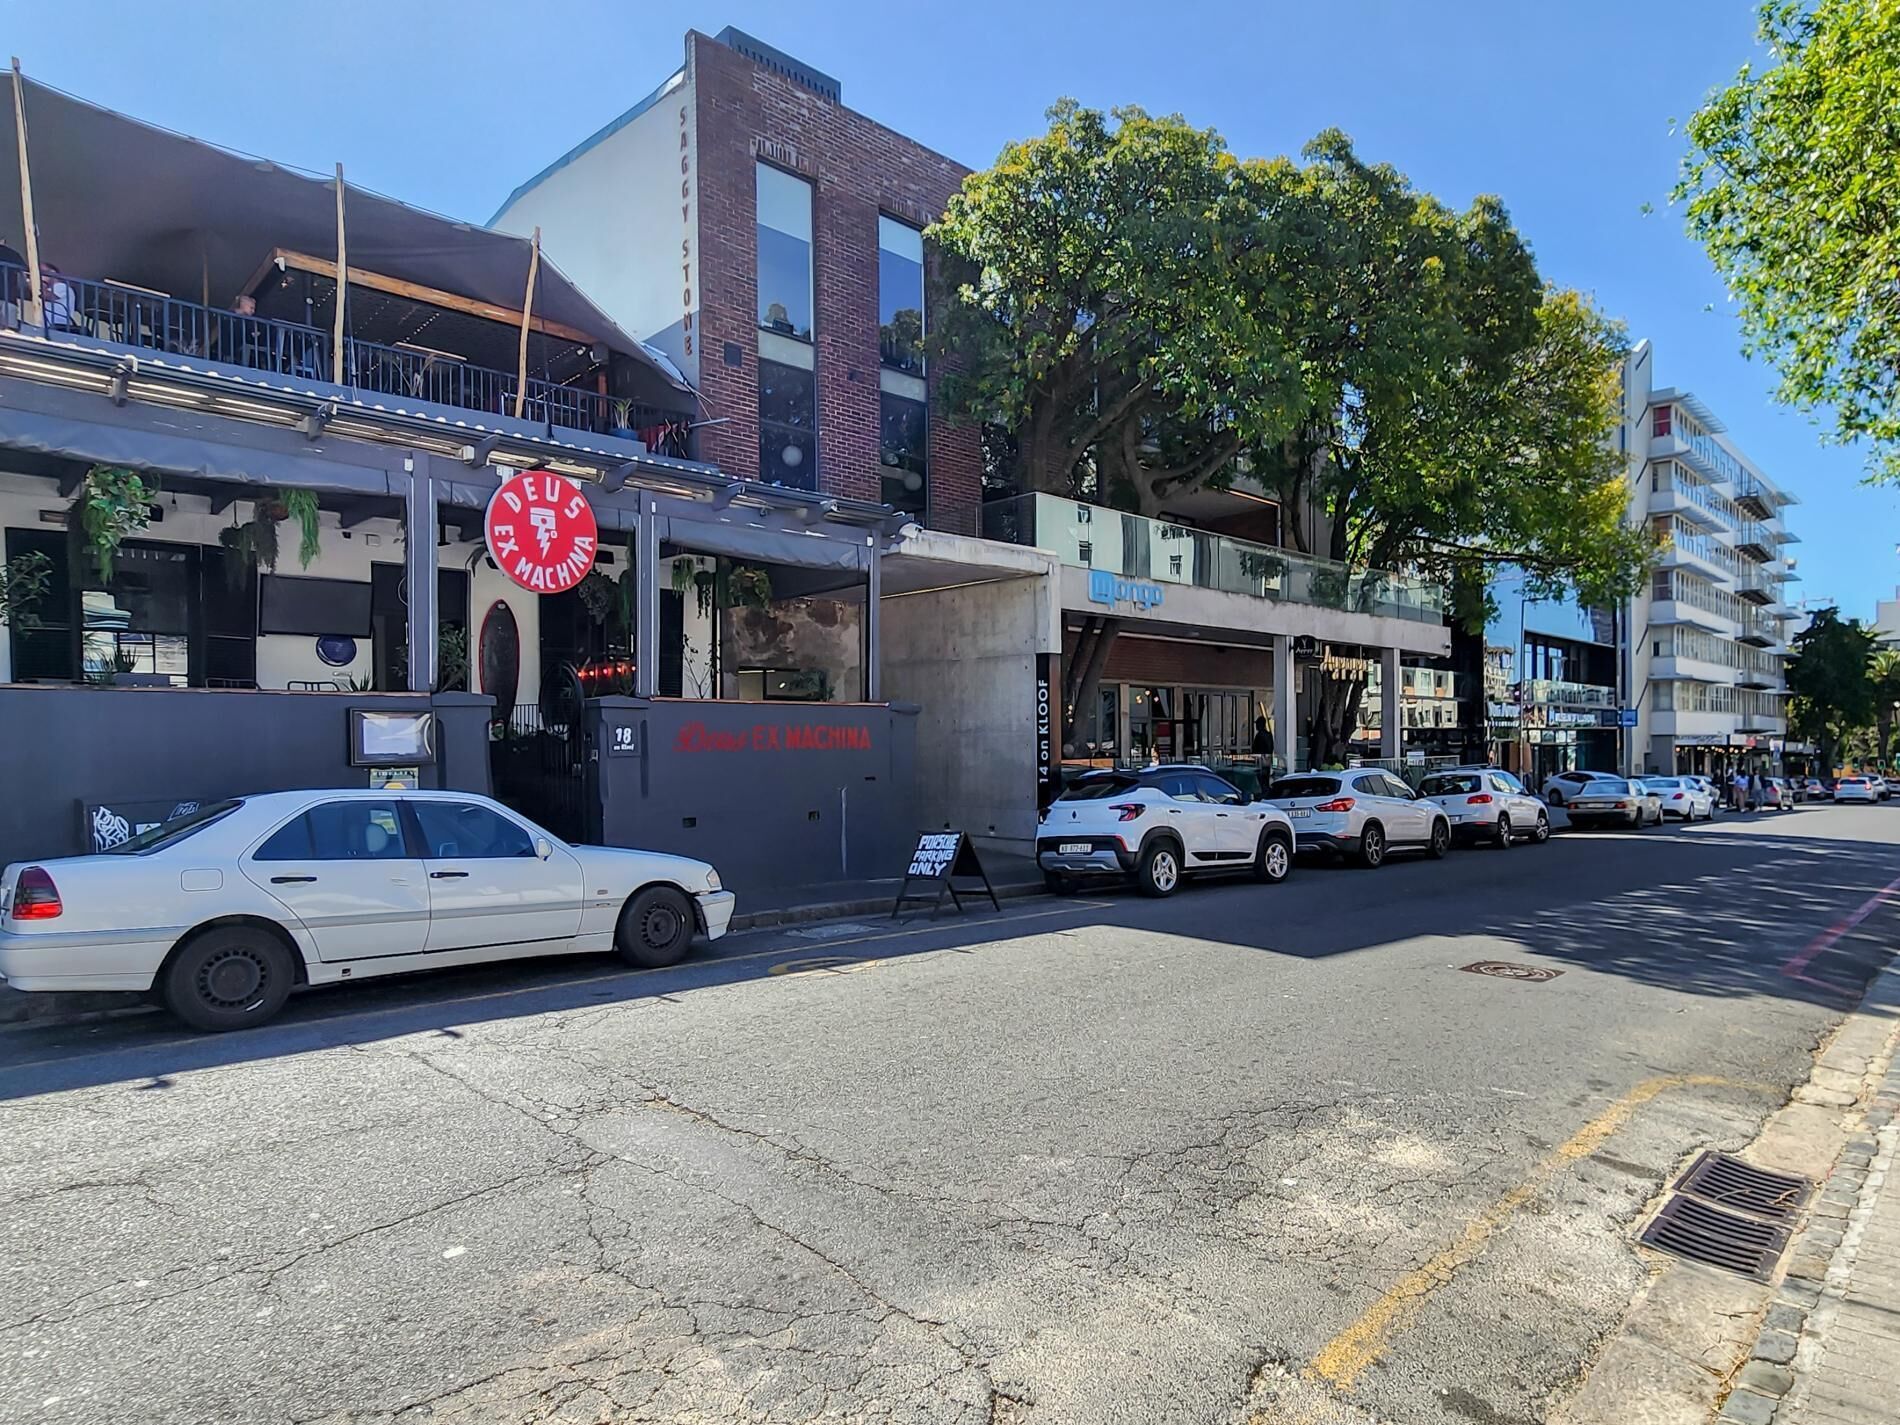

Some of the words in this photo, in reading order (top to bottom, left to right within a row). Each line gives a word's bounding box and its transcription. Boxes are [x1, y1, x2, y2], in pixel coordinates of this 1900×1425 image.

[679, 105, 690, 224] SAGGY
[682, 239, 693, 356] STONE
[502, 477, 585, 518] DEUS
[494, 525, 519, 558] EX
[515, 537, 594, 589] MACHINA
[1038, 680, 1049, 734] KLOOF
[616, 728, 632, 744] 18
[753, 725, 782, 751] EX
[785, 724, 872, 750] MACHINA
[1040, 740, 1049, 760] on
[1039, 766, 1049, 783] 14
[908, 861, 947, 876] ONLY
[913, 850, 954, 862] PARKING
